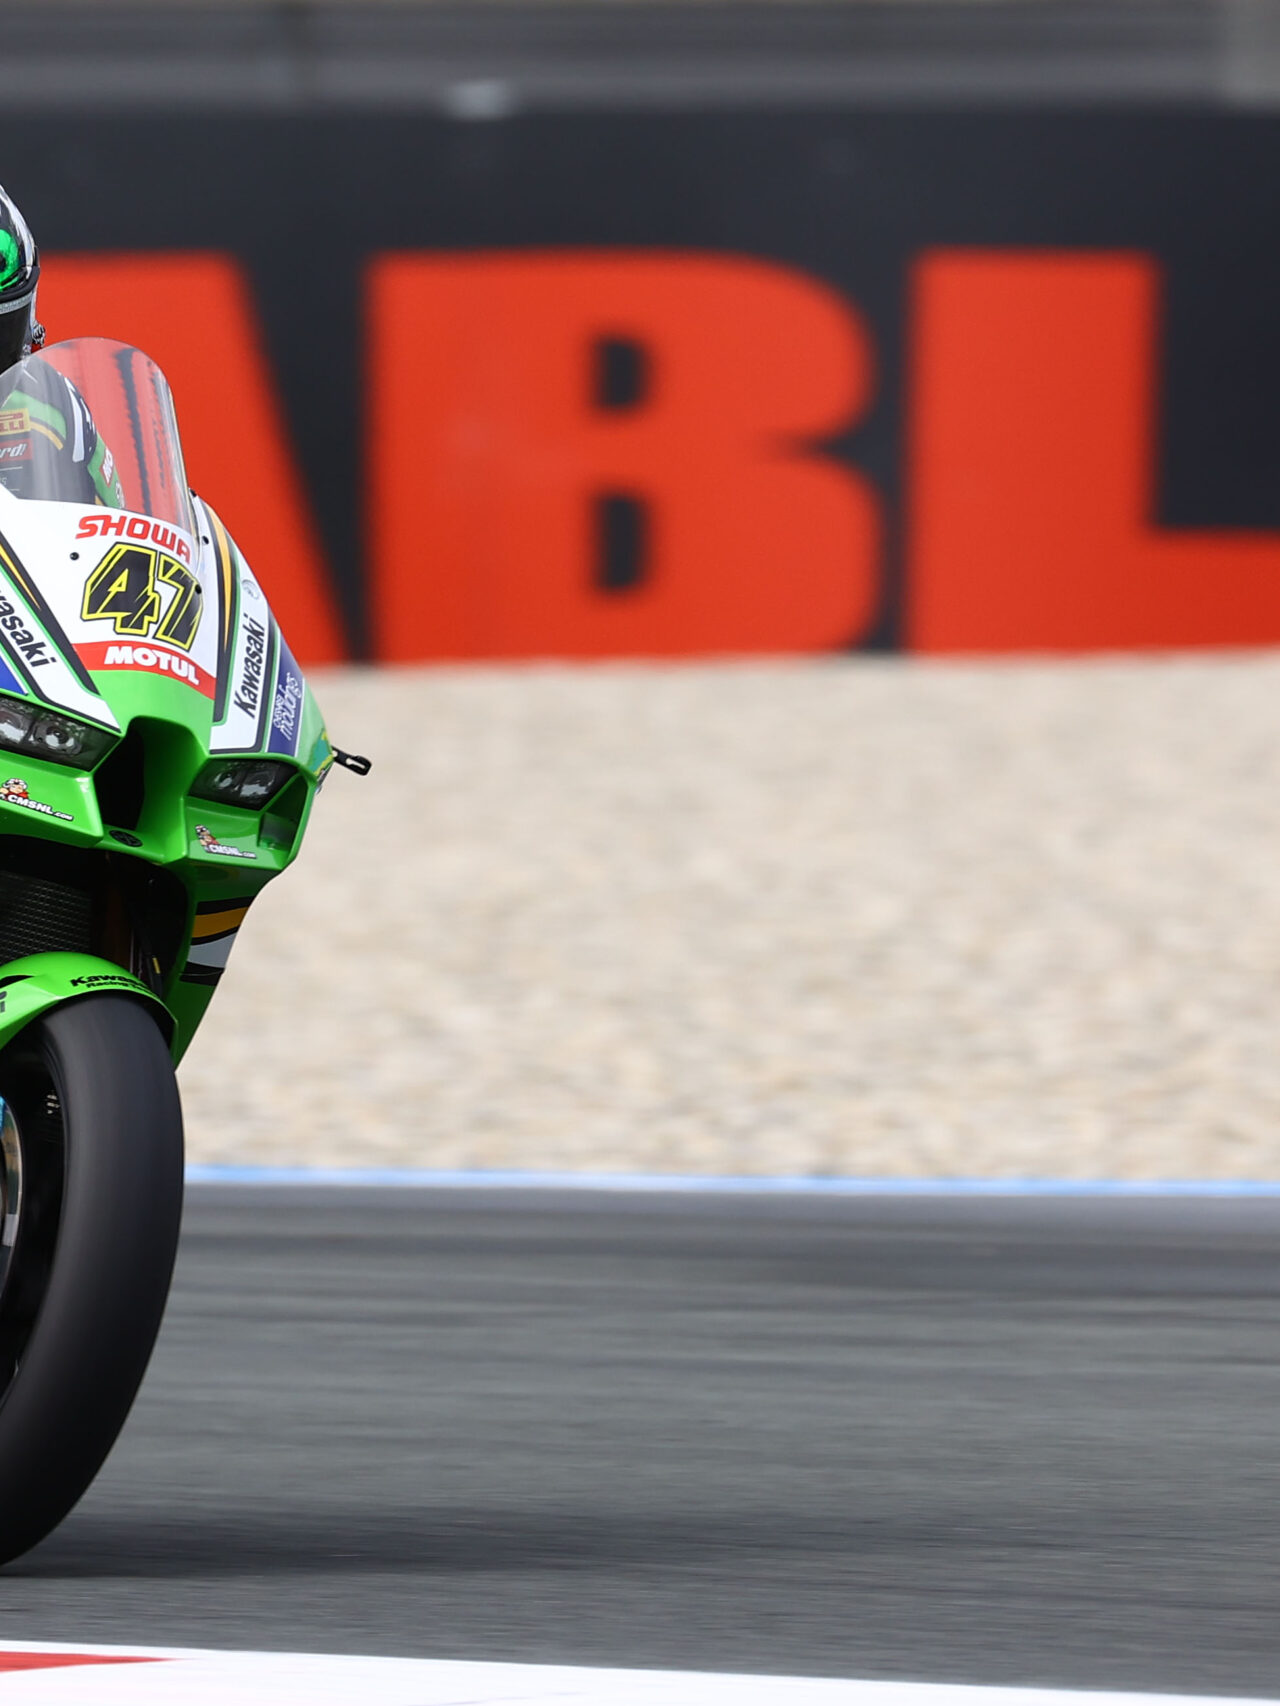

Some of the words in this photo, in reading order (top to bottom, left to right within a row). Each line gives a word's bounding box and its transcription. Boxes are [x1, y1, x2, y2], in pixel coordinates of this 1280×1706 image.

[75, 515, 191, 565] SHOWA
[80, 541, 204, 652] 47
[104, 646, 200, 685] MOTUL
[233, 612, 266, 719] Kawasaki
